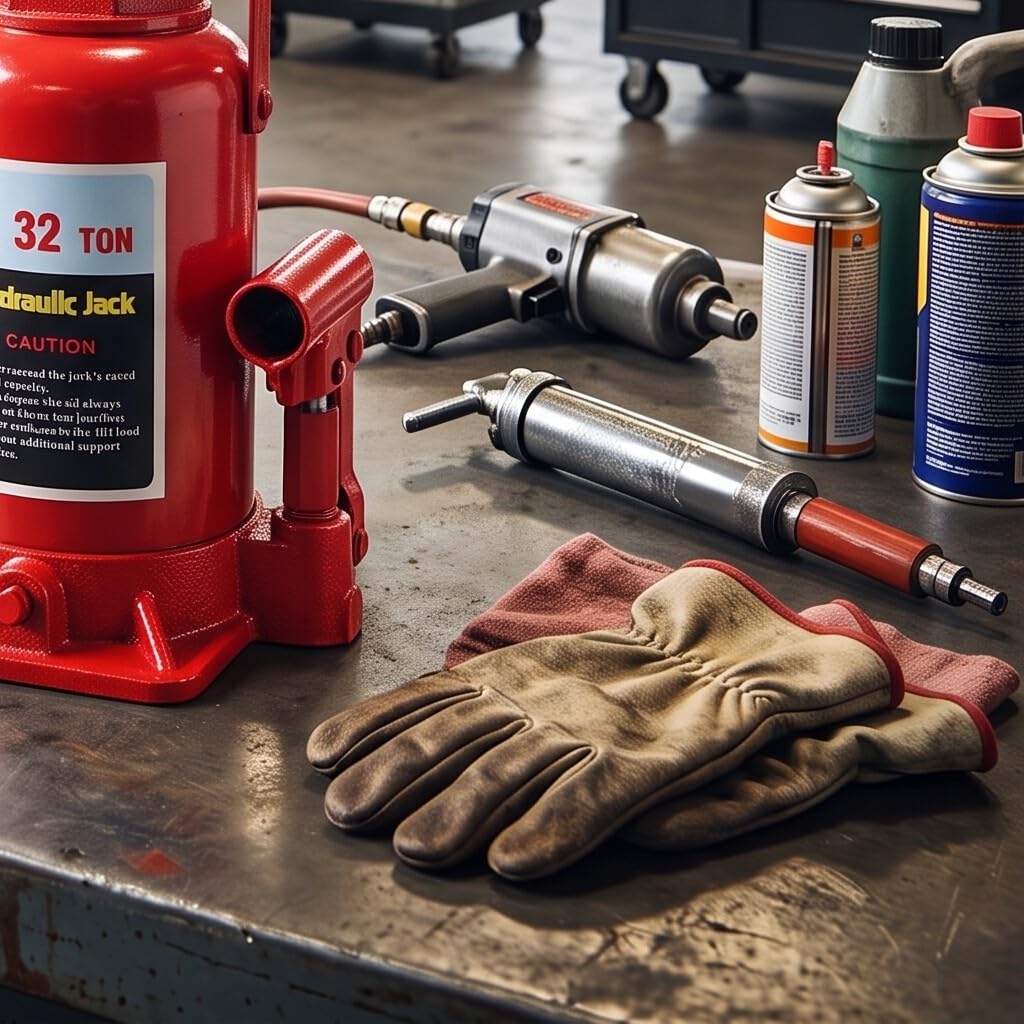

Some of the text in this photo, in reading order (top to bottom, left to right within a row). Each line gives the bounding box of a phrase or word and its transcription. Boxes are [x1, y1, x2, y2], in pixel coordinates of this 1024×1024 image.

[13, 210, 133, 254] 32 TON
[83, 291, 136, 316] Jack
[6, 333, 95, 354] CAUTION
[48, 370, 66, 380] the
[19, 437, 75, 451] additional
[77, 442, 121, 455] support
